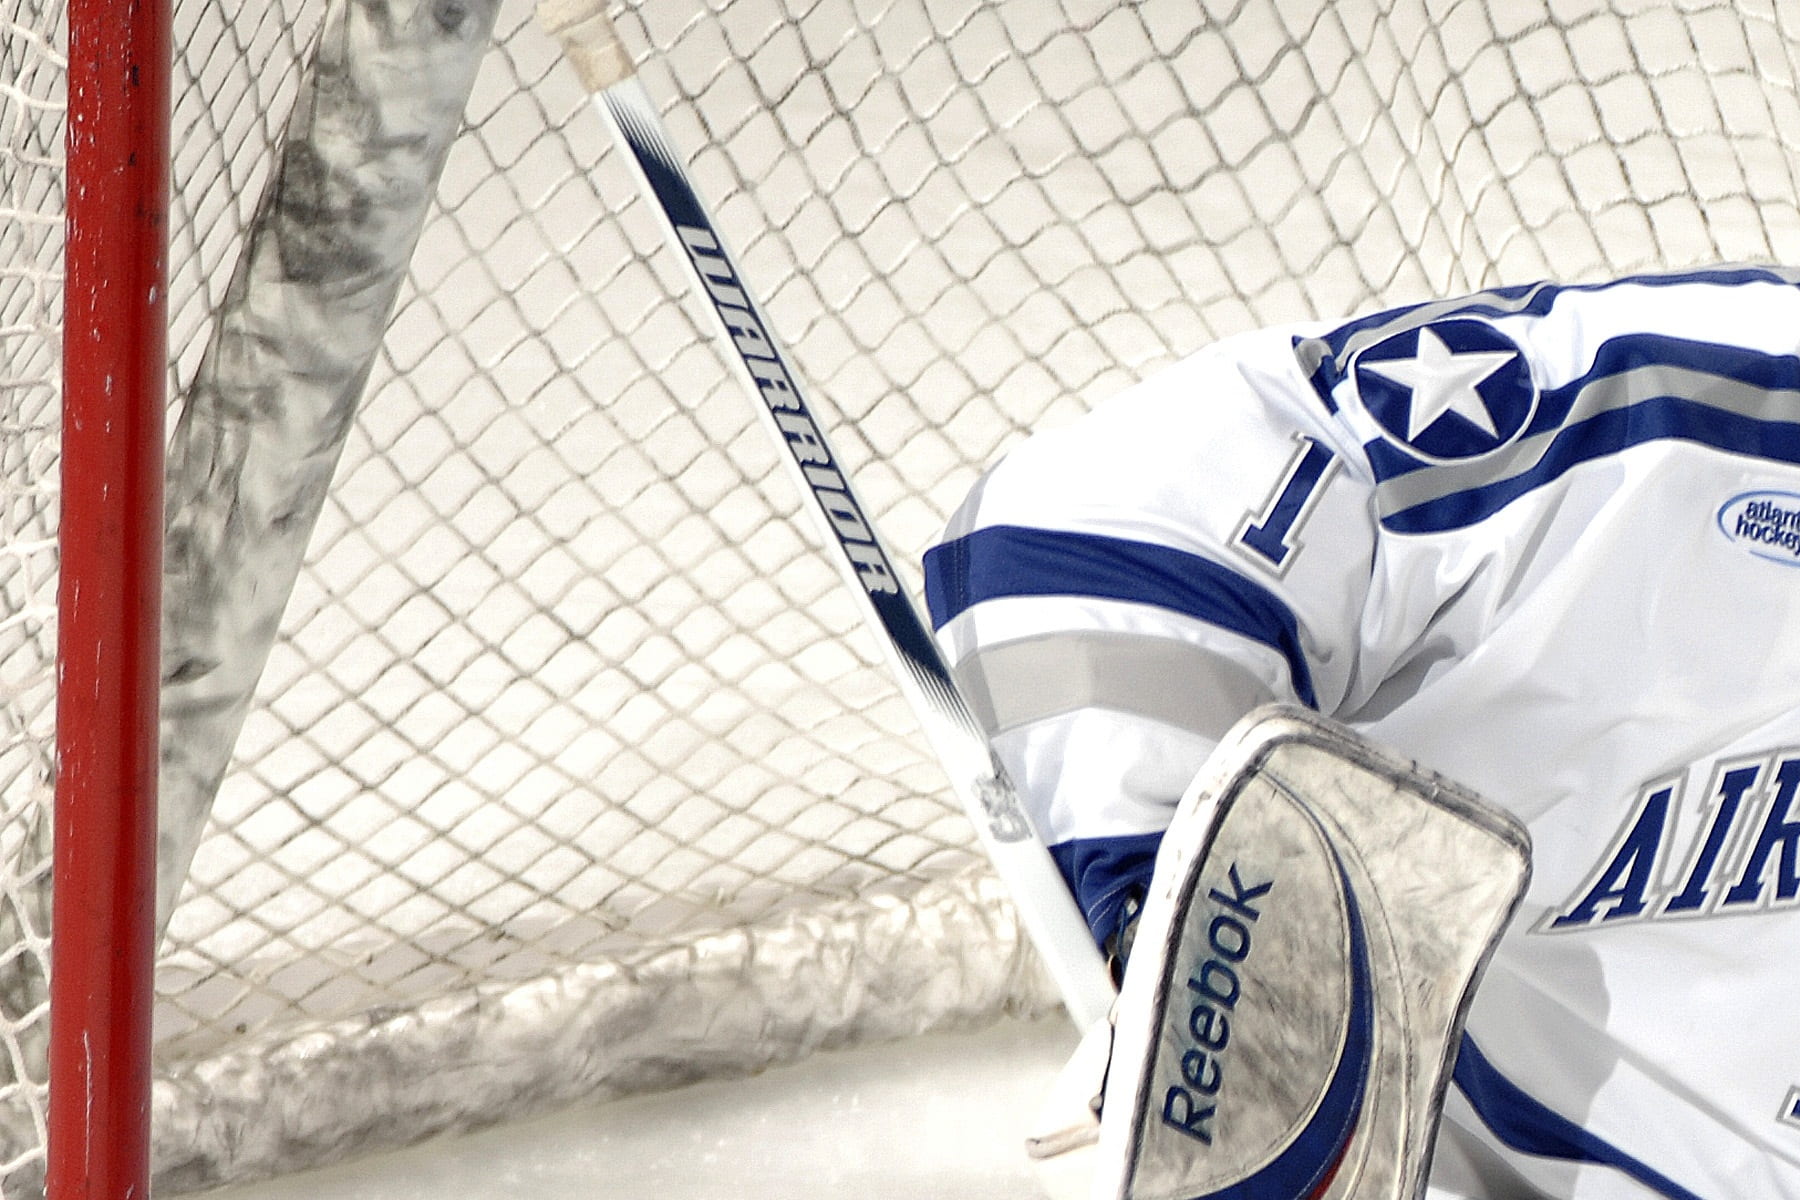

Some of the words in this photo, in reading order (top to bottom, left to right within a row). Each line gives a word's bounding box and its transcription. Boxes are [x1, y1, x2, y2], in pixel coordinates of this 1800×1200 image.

[676, 223, 900, 599] WARRIOR
[1226, 430, 1345, 580] 1
[1162, 861, 1274, 1146] Reebok
